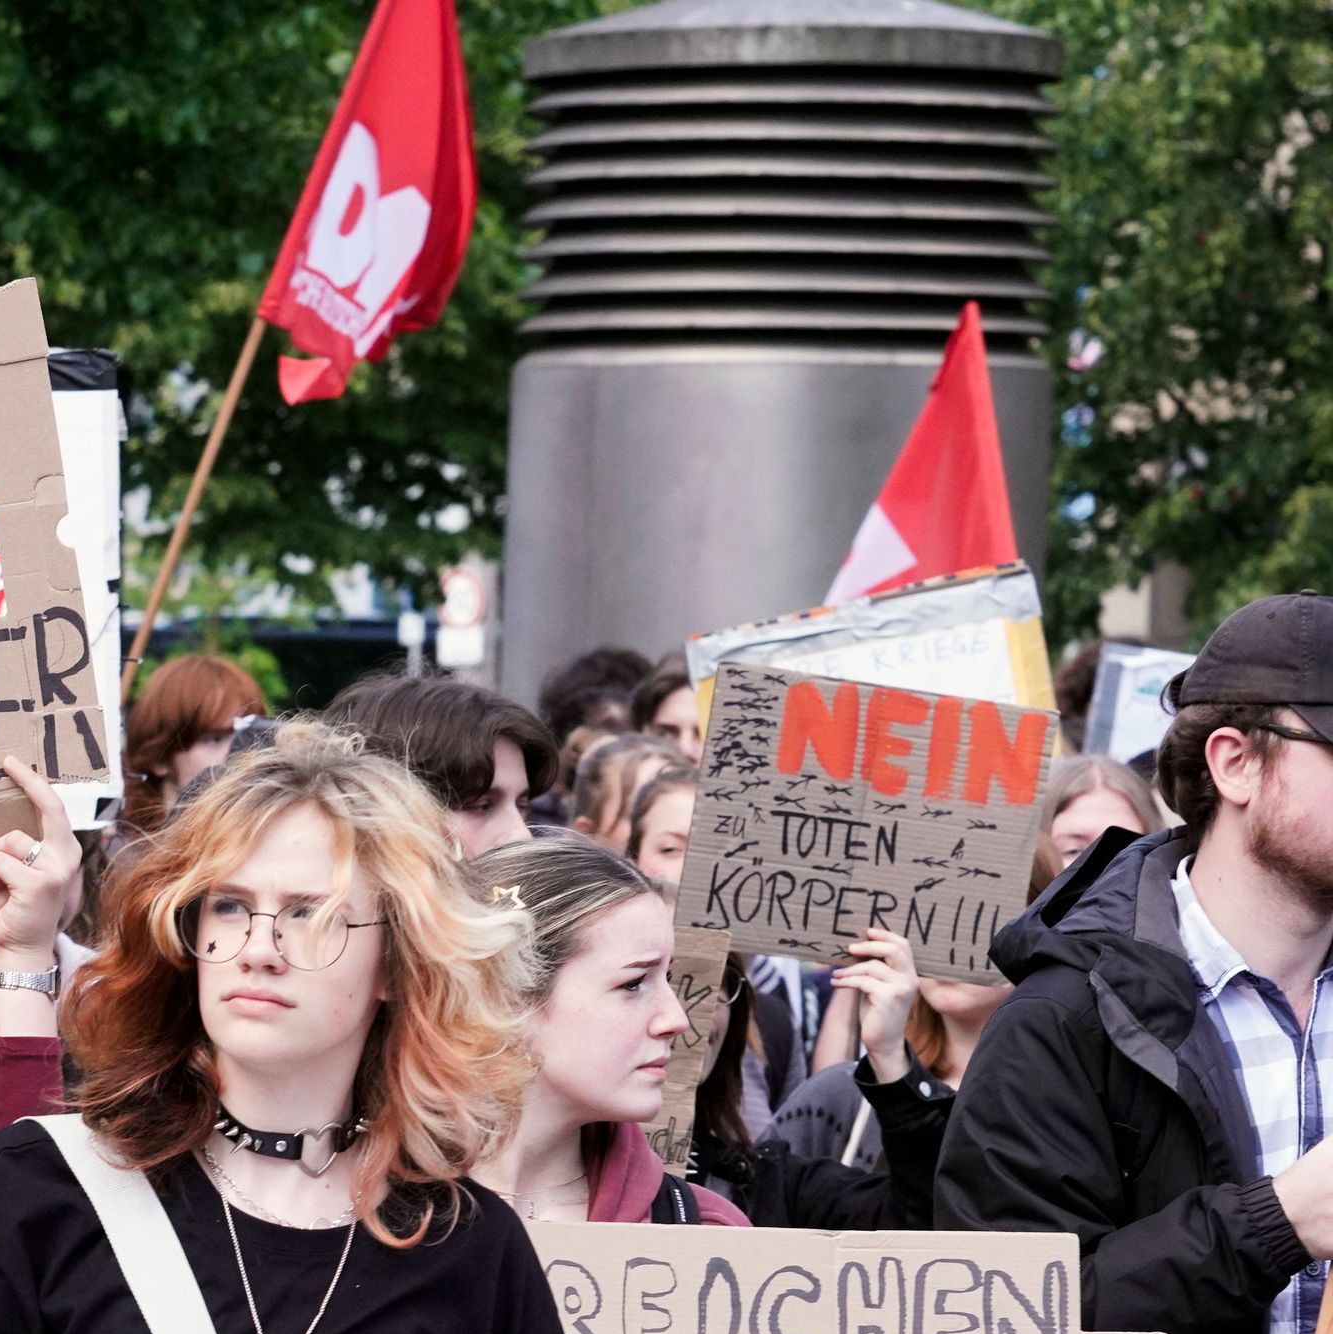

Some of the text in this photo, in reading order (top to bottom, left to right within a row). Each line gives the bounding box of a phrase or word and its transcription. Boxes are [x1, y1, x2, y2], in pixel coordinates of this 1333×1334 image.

[873, 631, 991, 672] KRIEGE
[775, 681, 1050, 808] NEIN
[769, 809, 899, 865] TOTEN
